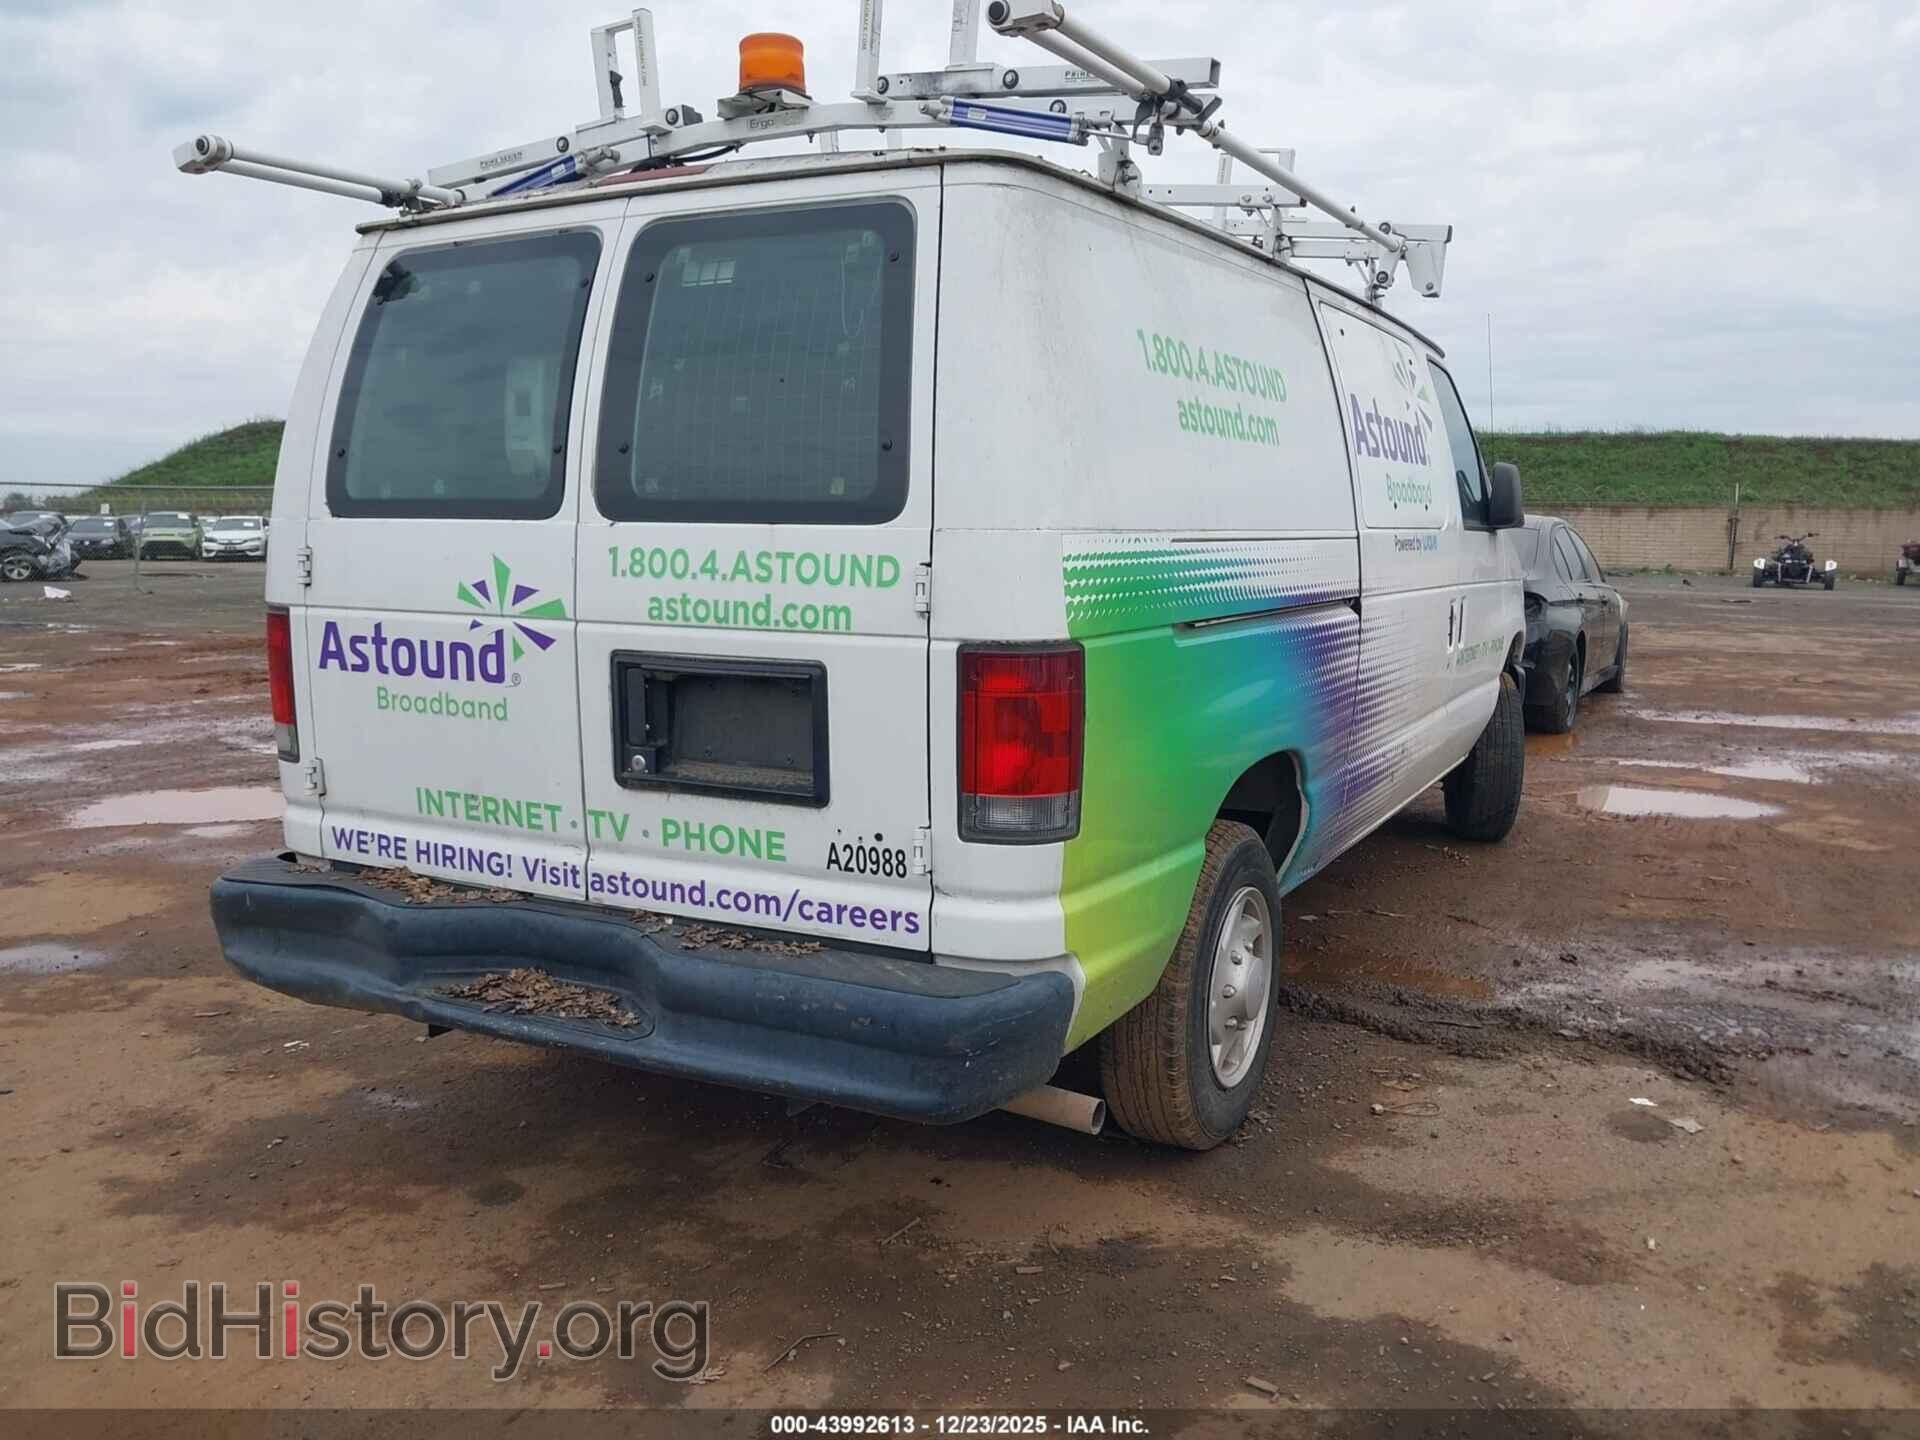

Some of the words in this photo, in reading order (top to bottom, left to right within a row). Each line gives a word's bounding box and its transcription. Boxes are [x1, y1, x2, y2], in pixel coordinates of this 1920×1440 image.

[1136, 328, 1288, 403] 1.800.4.ASTOUND
[1177, 397, 1280, 446] astound.com
[1350, 393, 1427, 466] Astound
[608, 546, 900, 588] 1.800.4.ASTOUND
[648, 593, 852, 630] astound.com
[318, 620, 506, 684] Astound
[376, 686, 508, 721] Broadband
[416, 786, 562, 833] INTERNET
[587, 809, 630, 842] TV
[661, 818, 787, 862] PHONE
[416, 839, 512, 878] HIRING!
[522, 856, 581, 889] Visit
[590, 871, 920, 934] astound.com/careers
[826, 842, 908, 878] A20988
